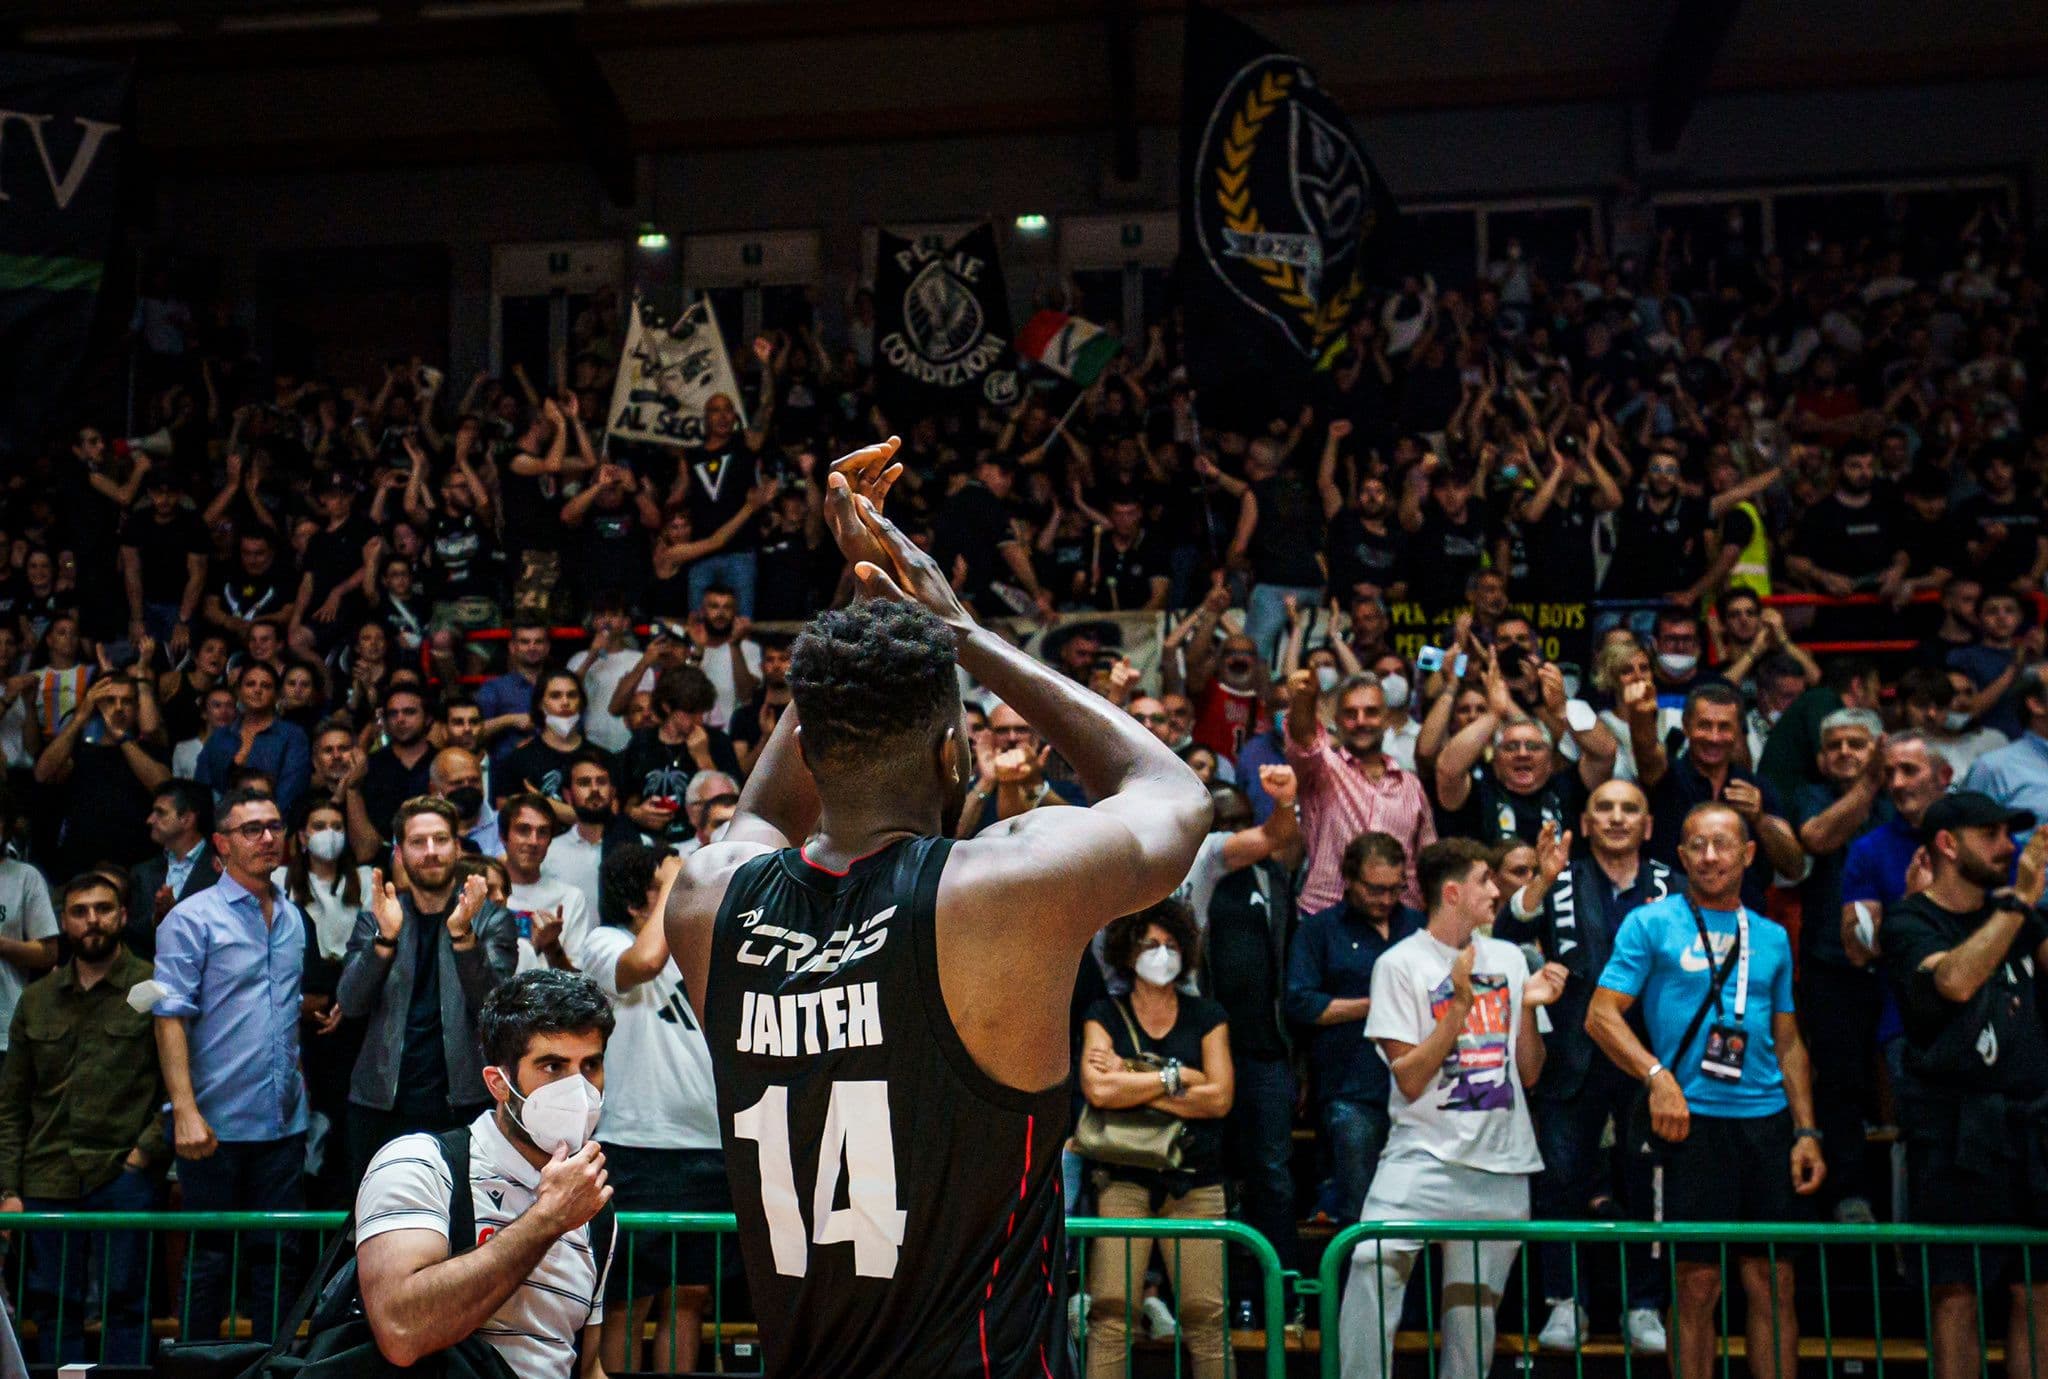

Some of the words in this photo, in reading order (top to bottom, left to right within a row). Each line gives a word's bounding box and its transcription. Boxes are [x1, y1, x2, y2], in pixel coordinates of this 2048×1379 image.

[1537, 602, 1586, 629] BOYS
[736, 981, 884, 1057] JAITEH
[733, 1080, 908, 1279] 14
